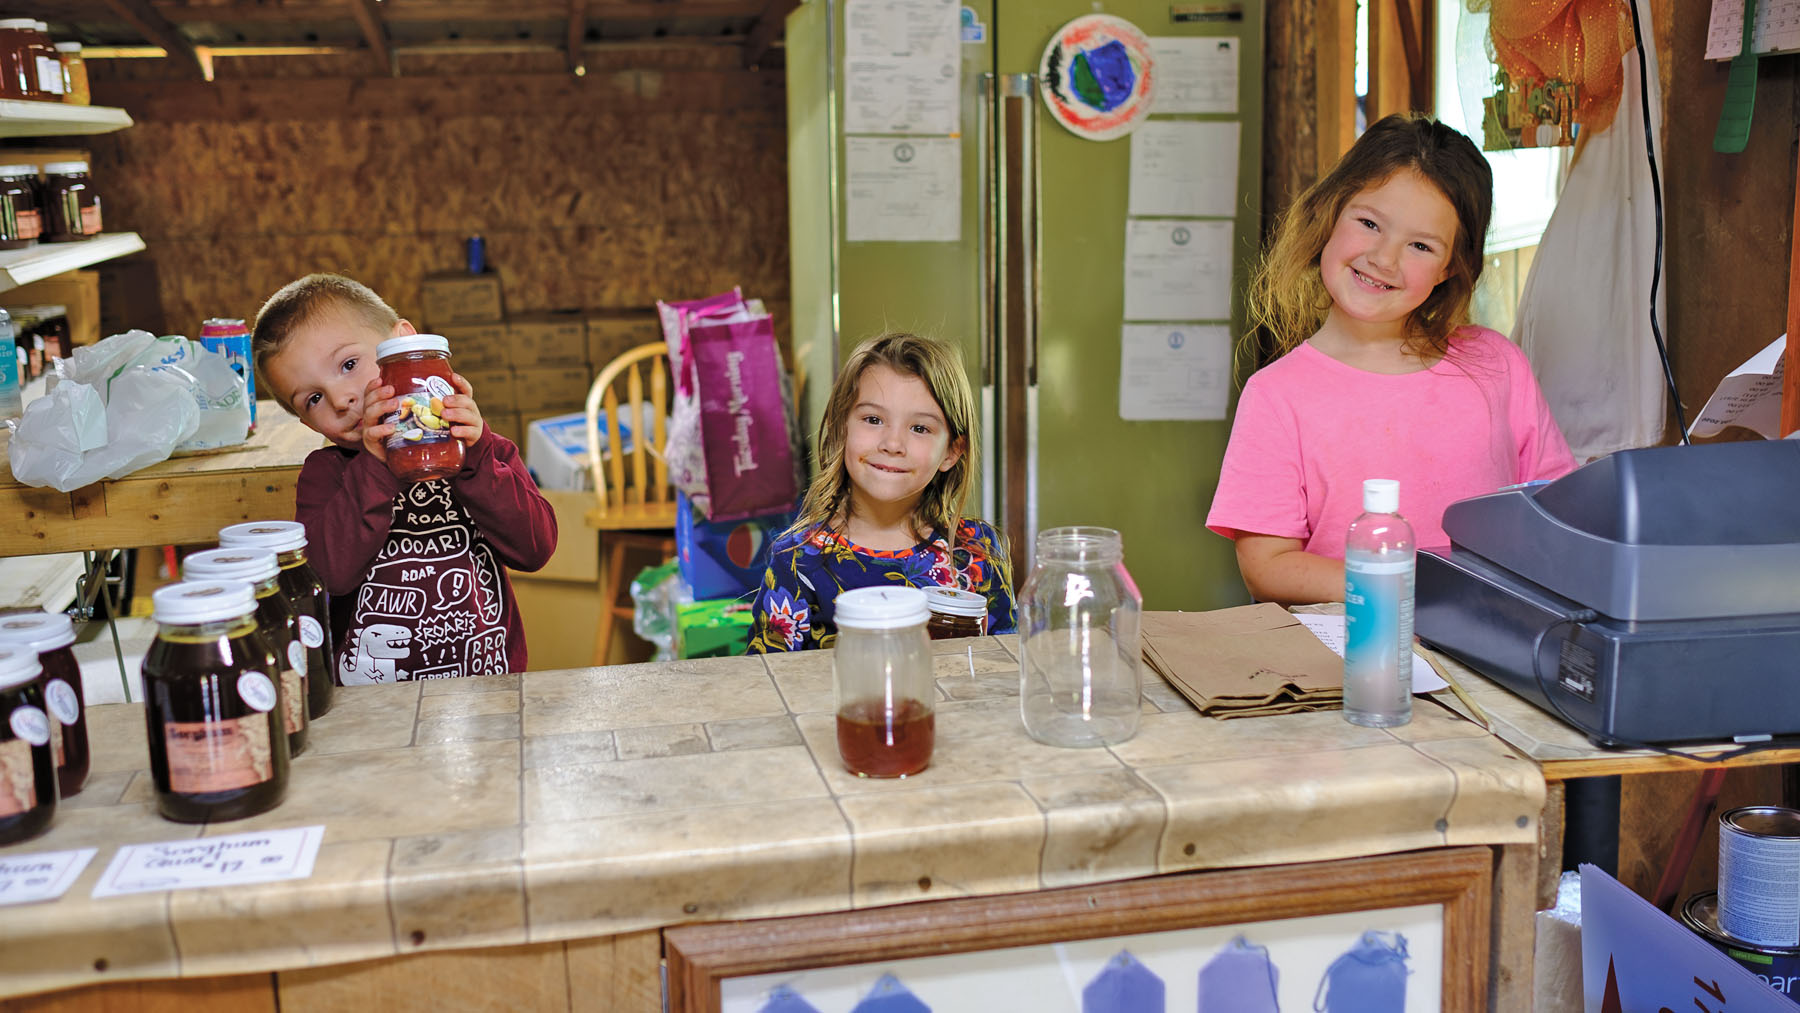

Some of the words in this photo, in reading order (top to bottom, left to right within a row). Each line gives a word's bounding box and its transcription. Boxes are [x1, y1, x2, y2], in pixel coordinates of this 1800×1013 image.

[407, 510, 459, 525] ROAR
[376, 530, 462, 561] OOOAR!
[401, 566, 436, 582] ROAR
[475, 552, 498, 619] ROAR
[361, 586, 417, 613] RAWR
[423, 617, 468, 639] ROAR!
